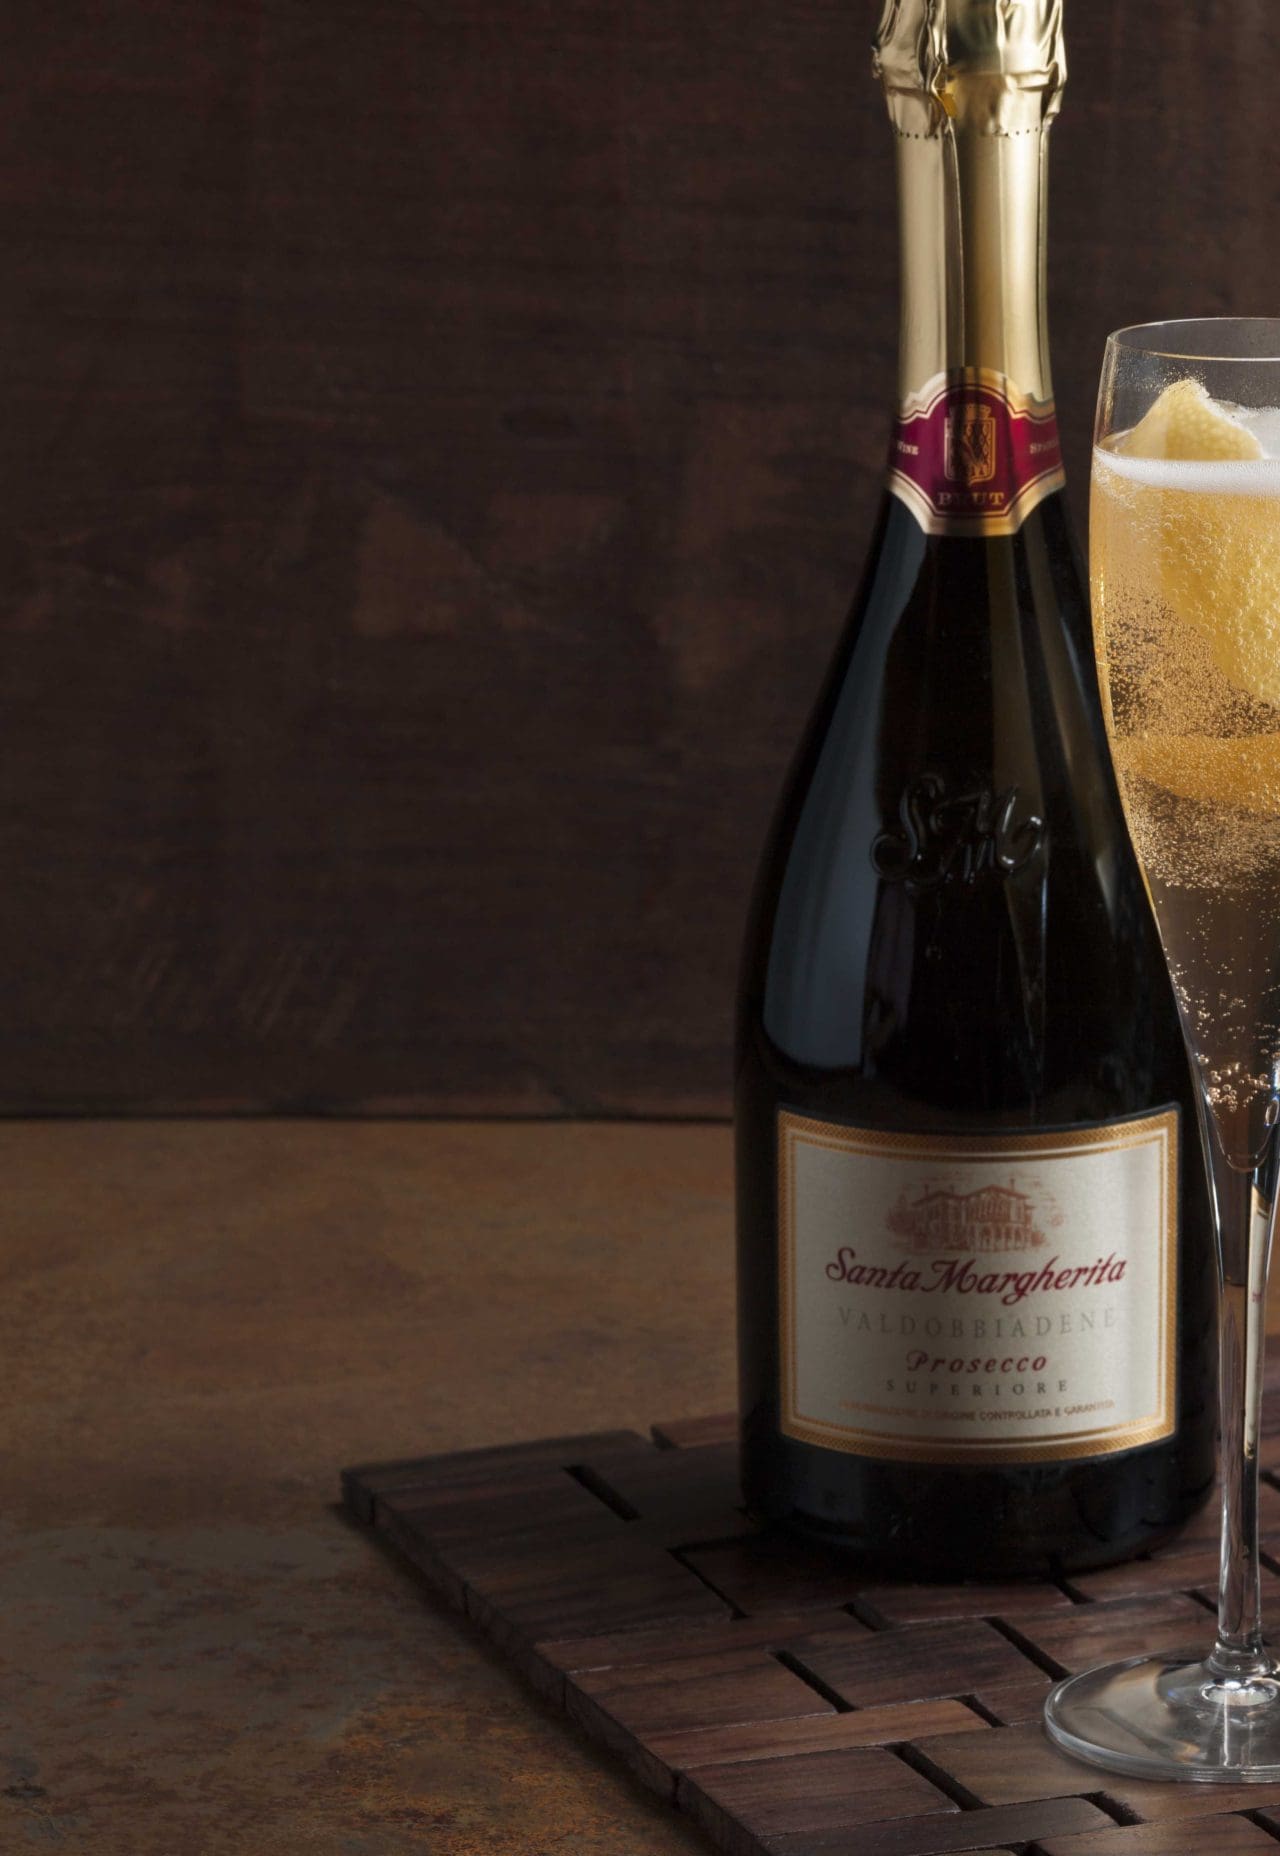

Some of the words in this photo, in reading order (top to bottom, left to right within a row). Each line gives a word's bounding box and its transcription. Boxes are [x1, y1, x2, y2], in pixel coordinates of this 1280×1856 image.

[825, 1246, 923, 1291] Santa
[921, 1252, 1128, 1307] Margherita
[837, 1307, 1117, 1338] VALDOBBIADENE
[906, 1349, 1048, 1375] Prosecco
[885, 1379, 1069, 1397] SUPERIORE
[980, 1408, 1051, 1422] CONTROLLATA
[1054, 1406, 1062, 1417] E
